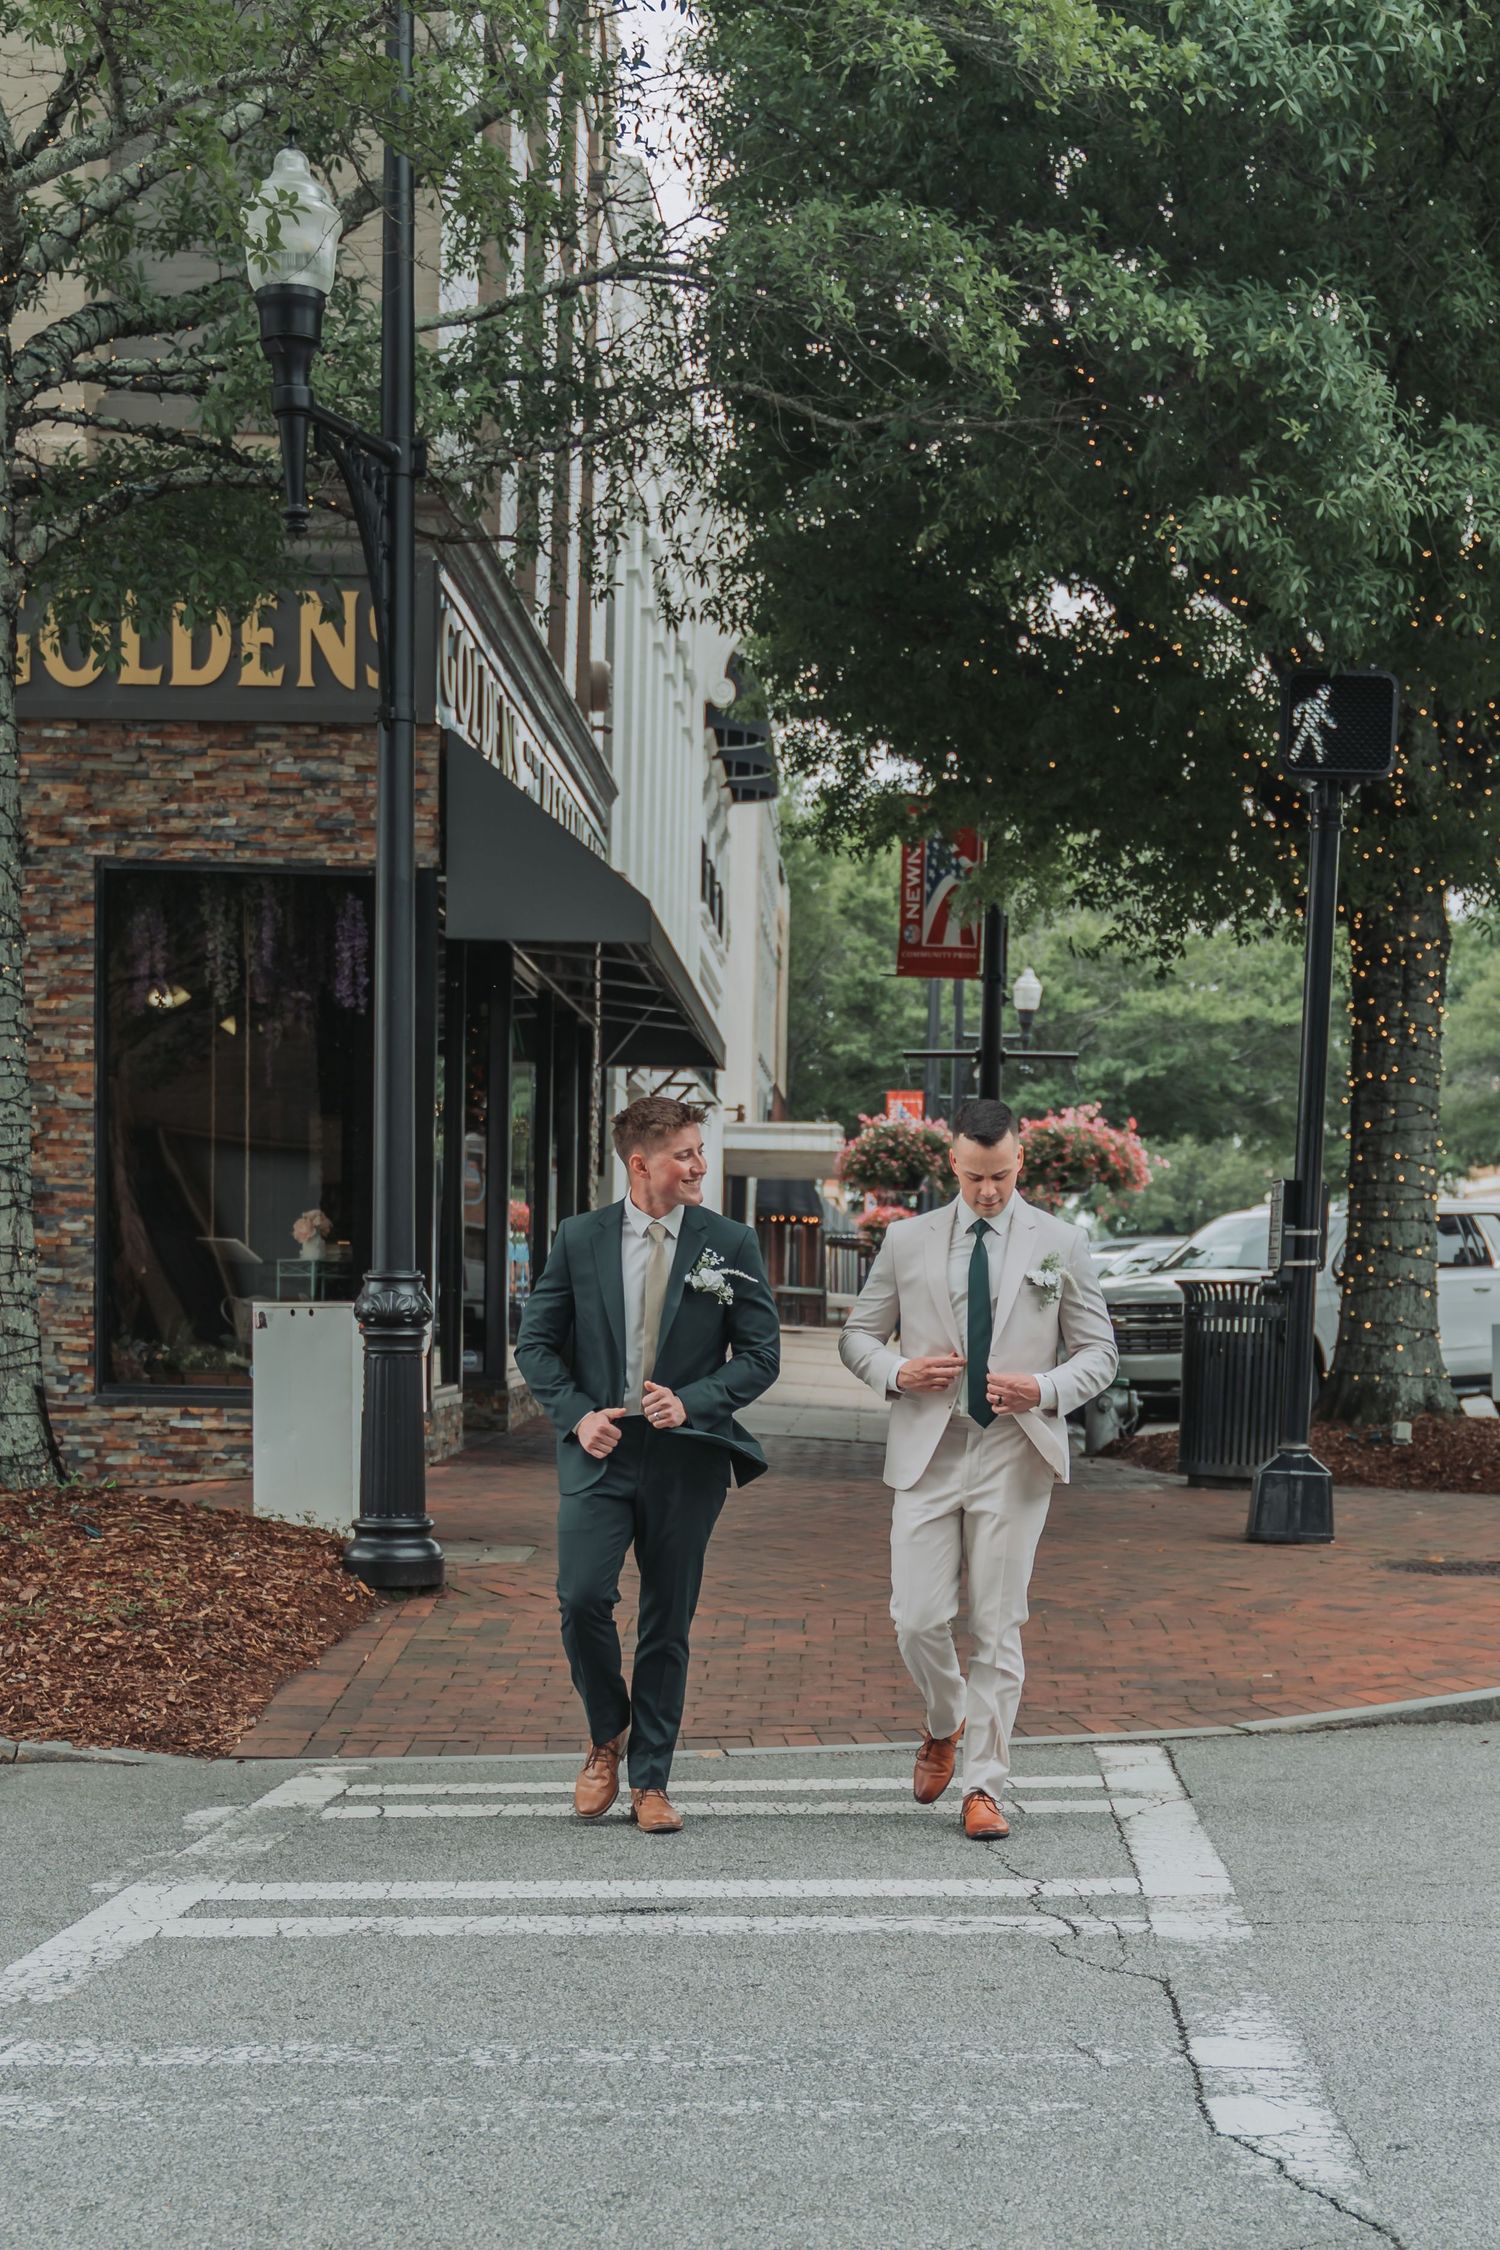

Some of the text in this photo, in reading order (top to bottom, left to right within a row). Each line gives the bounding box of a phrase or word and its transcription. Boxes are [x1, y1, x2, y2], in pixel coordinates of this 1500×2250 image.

[440, 603, 520, 786] GOLDENS
[905, 843, 922, 919] NEWN
[901, 951, 977, 960] COMMUNITY PRIDE
